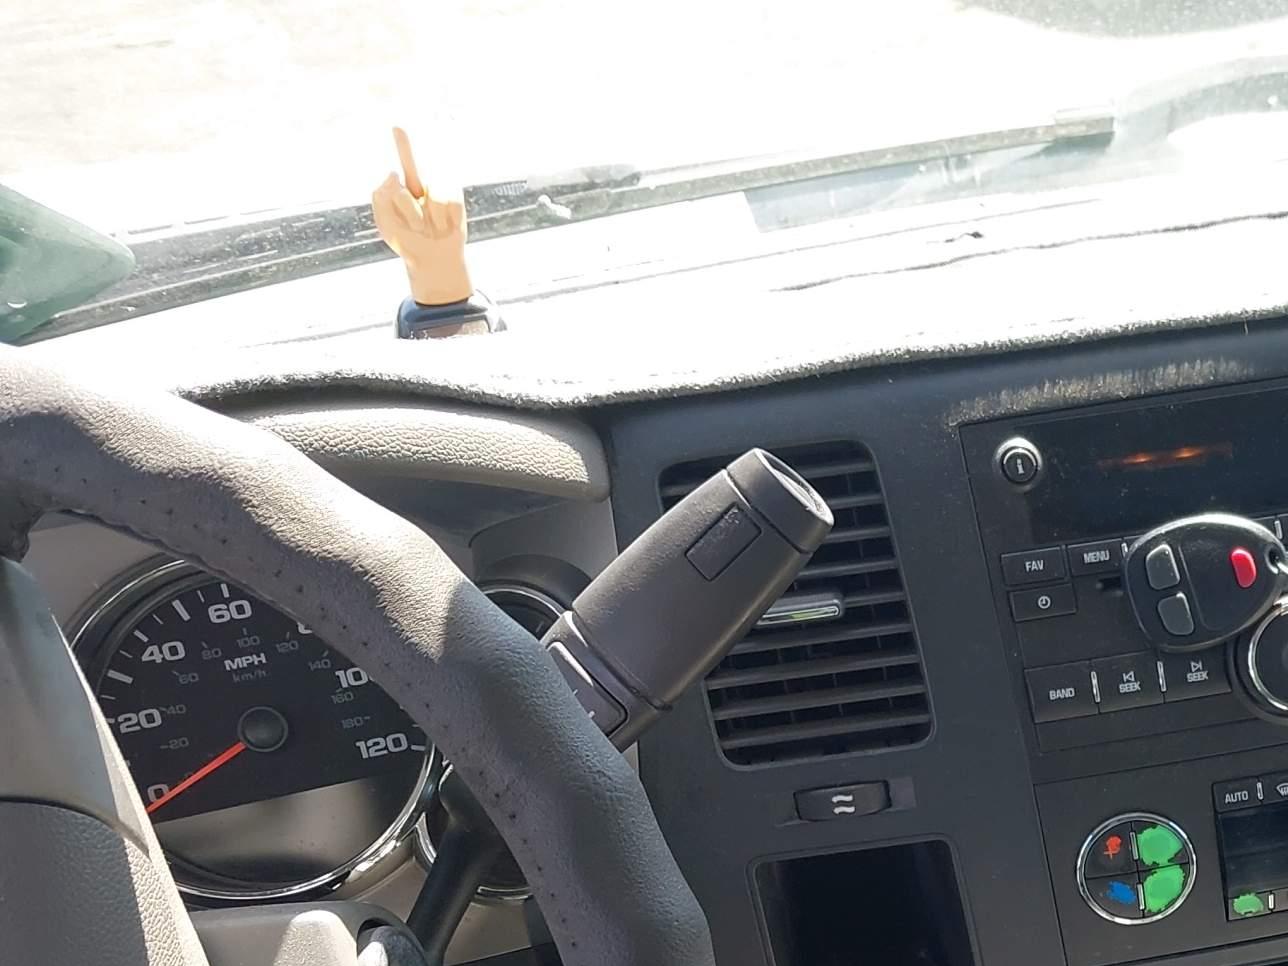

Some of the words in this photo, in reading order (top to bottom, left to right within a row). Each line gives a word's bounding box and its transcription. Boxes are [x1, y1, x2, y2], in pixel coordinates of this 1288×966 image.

[1083, 550, 1110, 564] MENU
[1025, 560, 1043, 572] FAV
[208, 600, 252, 624] 60
[236, 636, 261, 649] 100
[275, 640, 299, 654] 120
[141, 641, 185, 663] 40
[202, 646, 222, 660] 80
[224, 652, 267, 671] MPH
[308, 657, 331, 672] 140
[232, 671, 267, 684] km/h
[336, 667, 374, 689] 10
[1187, 670, 1209, 682] SEEK
[1119, 680, 1141, 692] SEEK
[1049, 687, 1075, 700] BAND
[166, 703, 187, 715] 40
[118, 708, 162, 734] 20
[169, 736, 190, 750] 20
[355, 732, 408, 759] 120
[1225, 790, 1249, 804] AUTO
